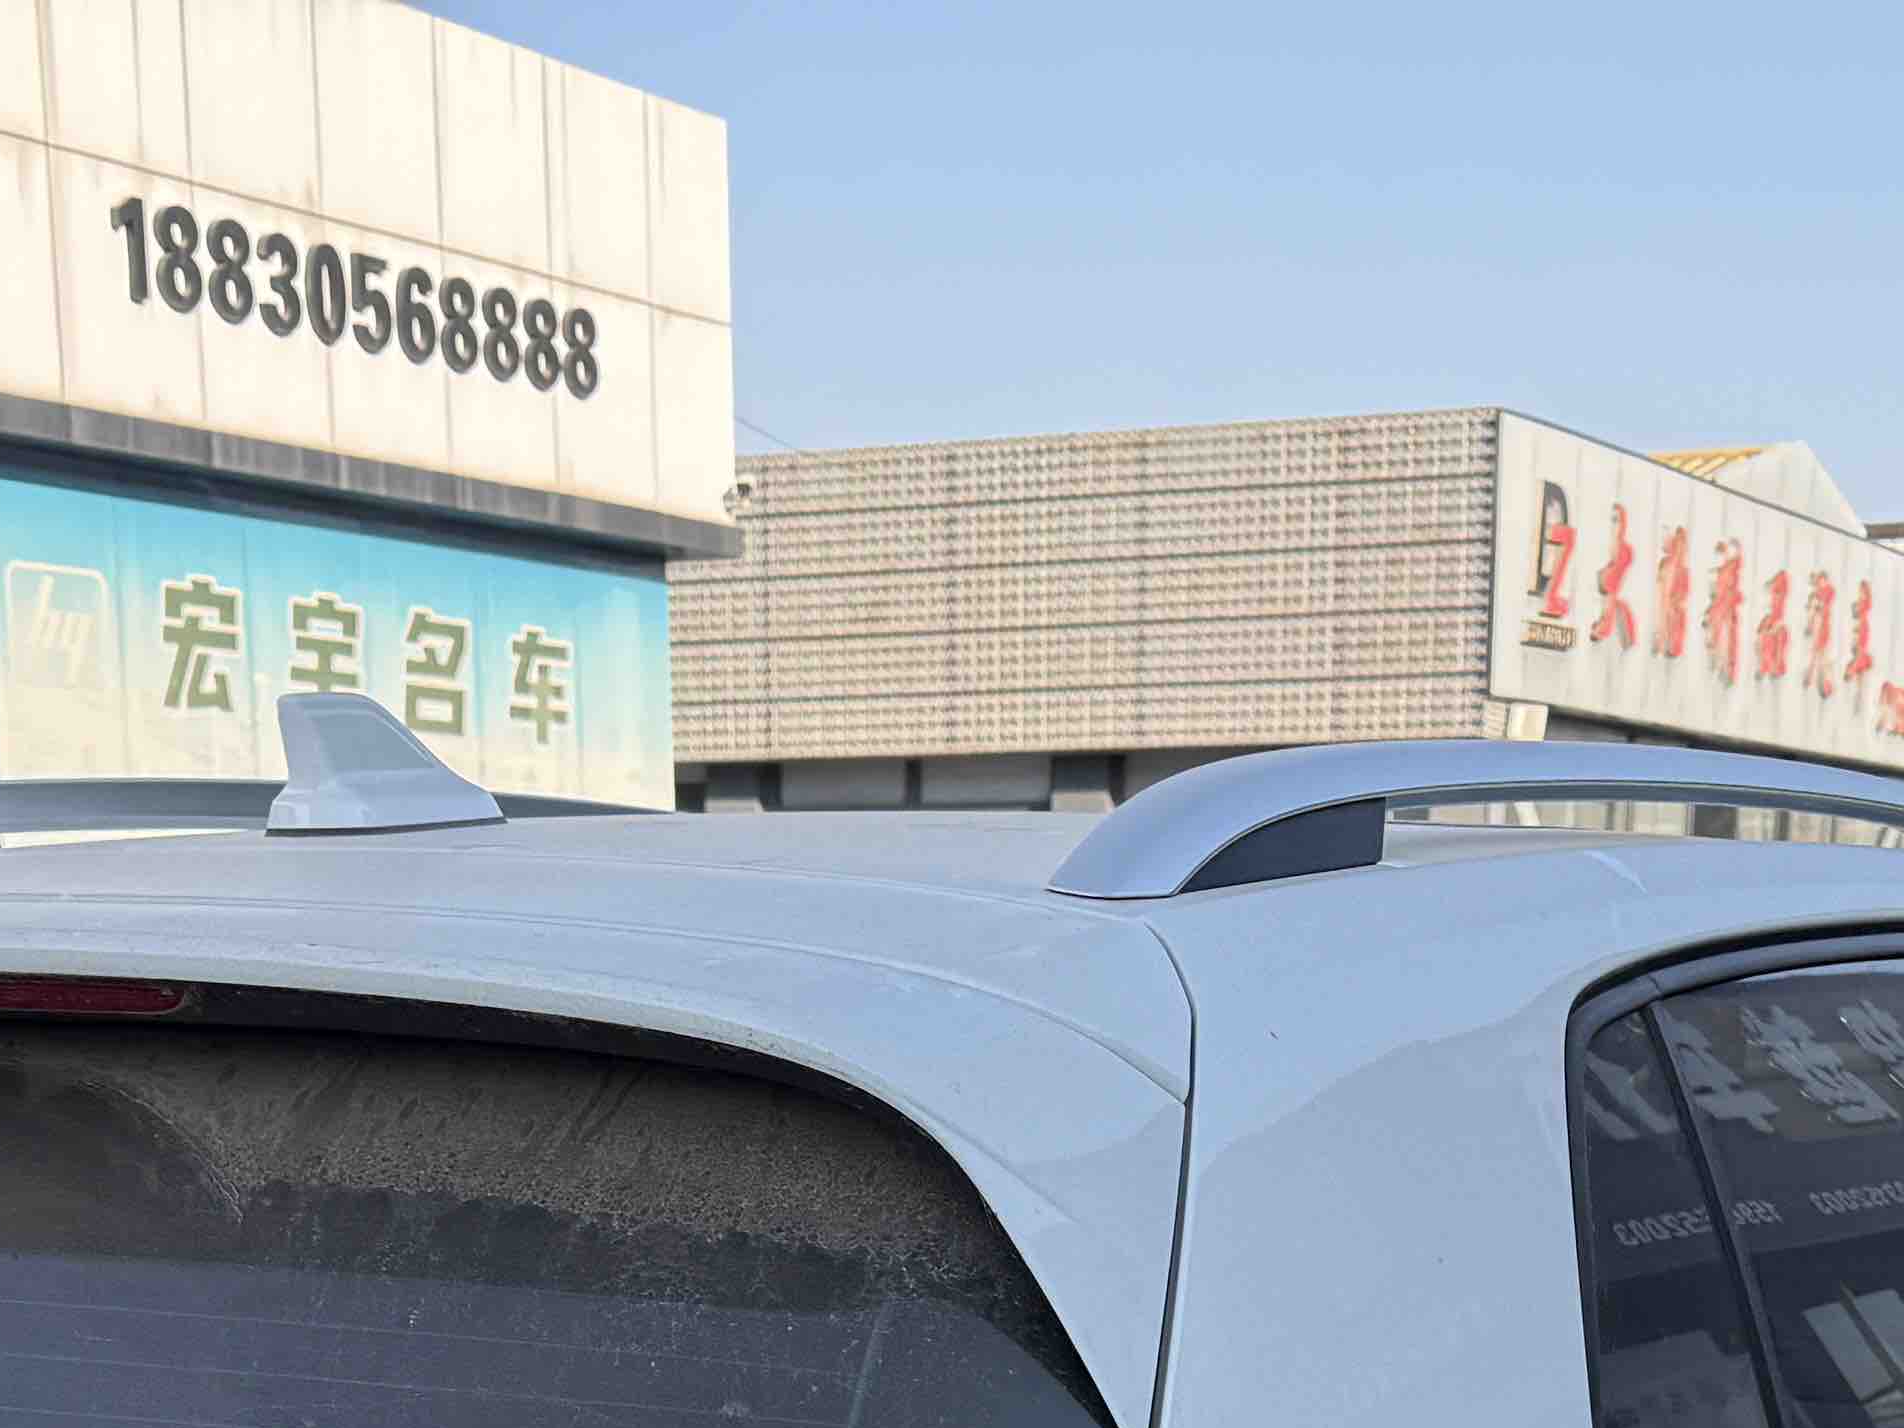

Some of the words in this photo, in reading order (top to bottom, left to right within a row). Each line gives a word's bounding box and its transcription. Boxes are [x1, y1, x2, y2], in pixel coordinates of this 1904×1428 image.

[110, 197, 599, 401] 18830568888
[161, 574, 573, 746] 宏宝名车
